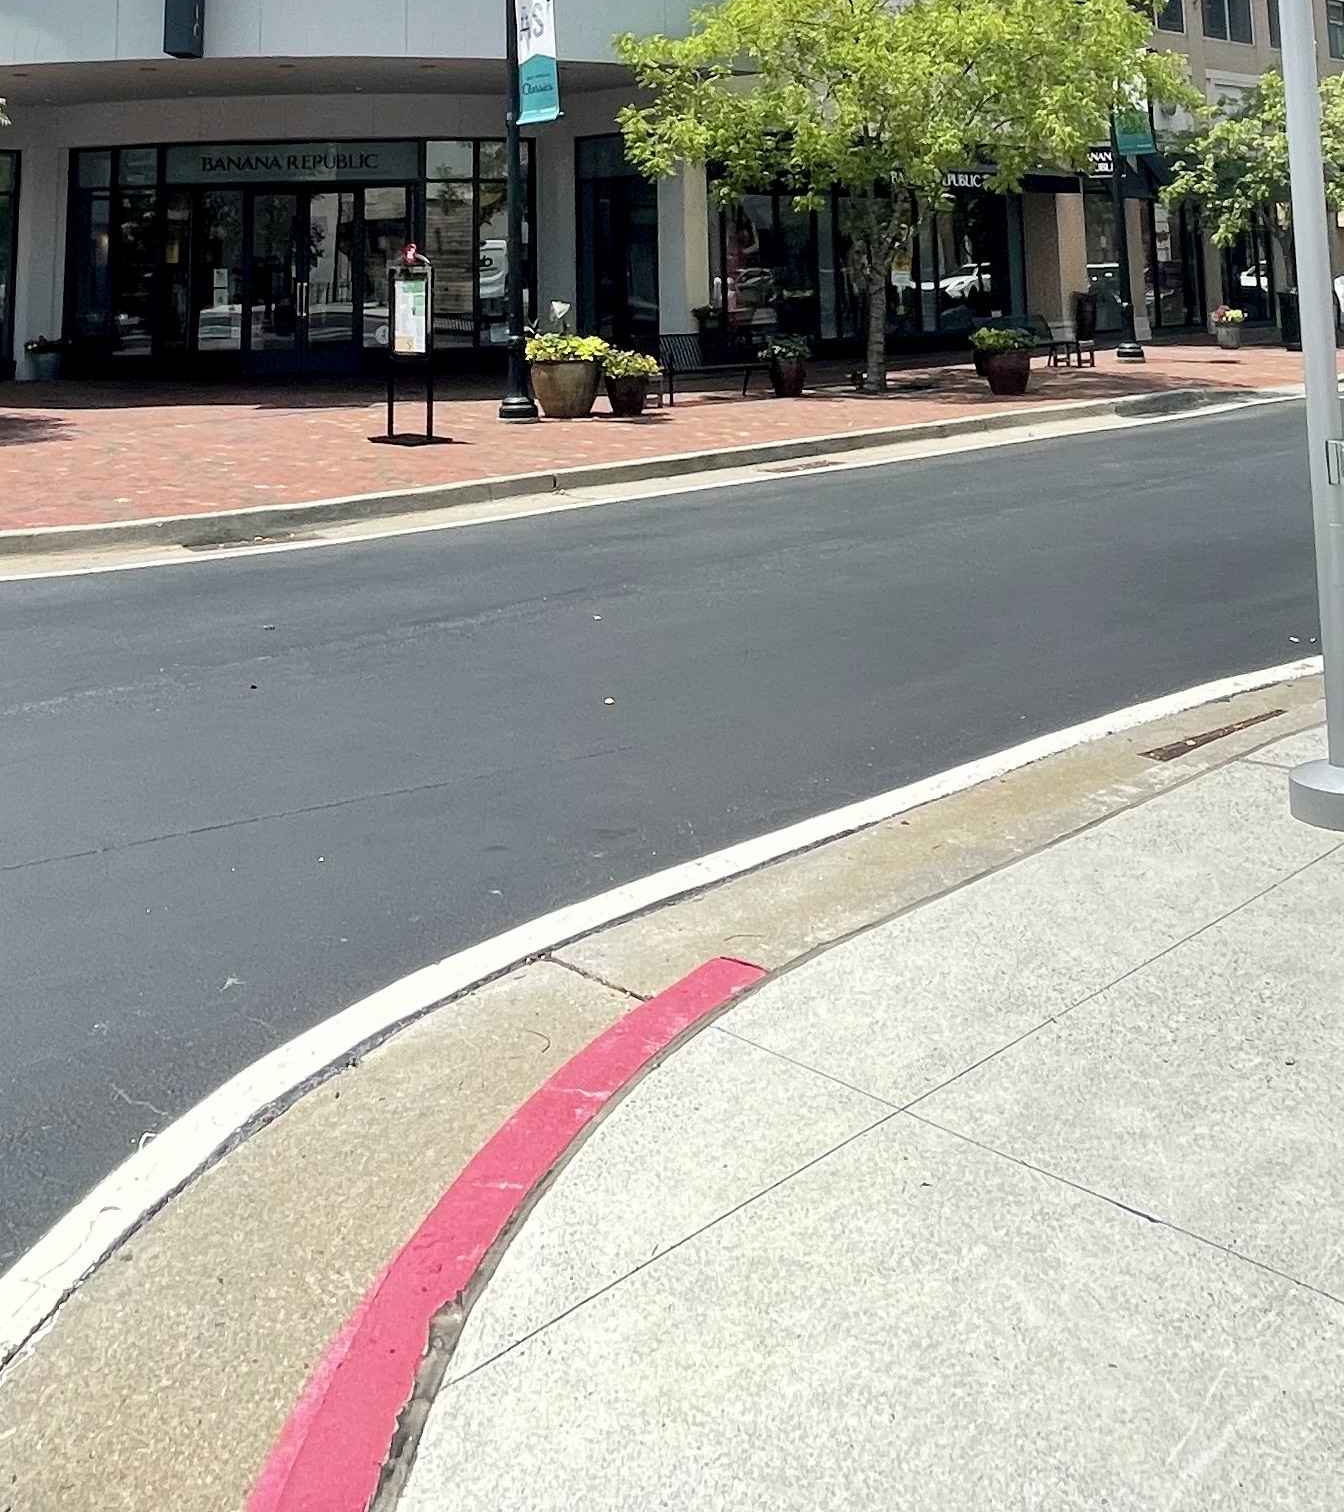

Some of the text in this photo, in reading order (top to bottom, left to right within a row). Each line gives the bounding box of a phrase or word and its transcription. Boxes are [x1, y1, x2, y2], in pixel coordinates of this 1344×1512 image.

[202, 152, 380, 172] BANANA REPUBLIC
[942, 172, 982, 187] PUBLIC
